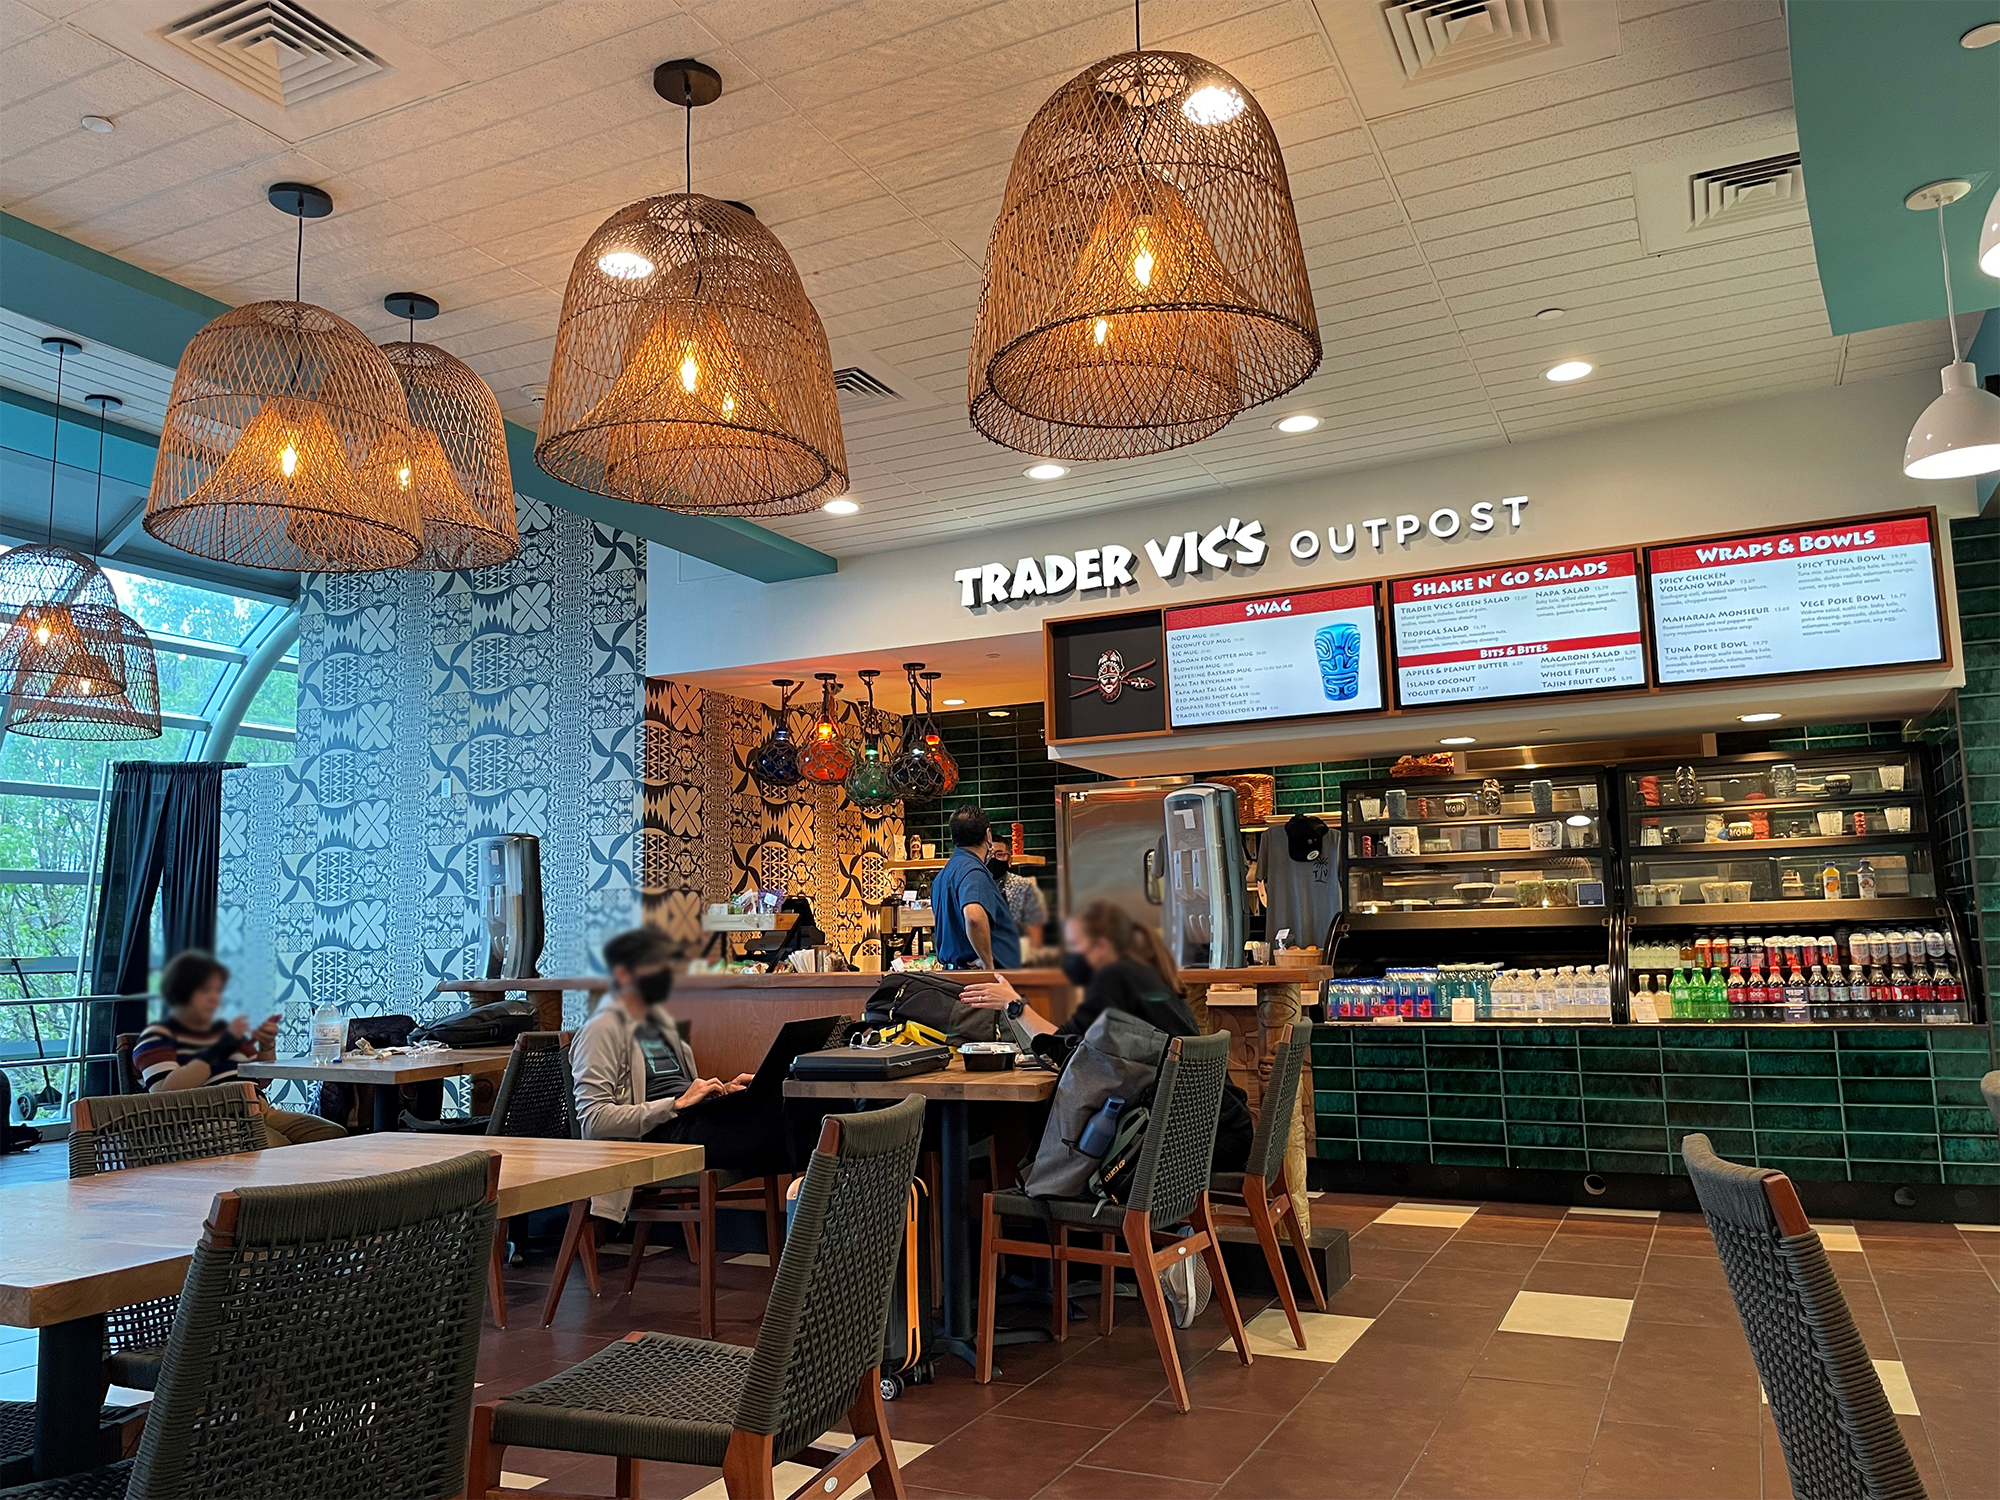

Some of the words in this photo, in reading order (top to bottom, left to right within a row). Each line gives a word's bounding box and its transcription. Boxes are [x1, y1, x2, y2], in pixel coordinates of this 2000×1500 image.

[954, 544, 1137, 608] TRADER
[1144, 517, 1268, 578] VIC'S
[1289, 495, 1529, 559] OUTPOST
[1696, 542, 1772, 564] WRAPS
[1778, 538, 1794, 554] &
[1800, 530, 1876, 552] BOWLS
[1797, 561, 1823, 569] SPICY
[1857, 554, 1885, 562] BOWL
[1412, 576, 1473, 597] SHAKE
[1499, 569, 1529, 586] GO
[1533, 559, 1608, 582] SALADS
[1659, 576, 1683, 585] SPICY
[1685, 572, 1725, 581] CHICKEN
[1562, 586, 1589, 594] SALAD
[1659, 582, 1704, 592] VOLCANO
[1706, 579, 1734, 587] WRAP
[1400, 605, 1431, 614] TRADER
[1454, 599, 1480, 607] GREEN
[1483, 596, 1509, 604] SALAD
[1800, 599, 1824, 607] VEGE
[1827, 597, 1852, 605] POKE
[1856, 594, 1885, 602] BOWL
[1246, 598, 1292, 617] SWAG
[1662, 613, 1715, 623] MAHARAJA
[1718, 607, 1769, 617] MONSIEUR
[1402, 628, 1440, 637] TROPICAL
[1443, 625, 1468, 633] SALAD
[1479, 647, 1504, 658] BITS
[1505, 646, 1515, 655] &
[1516, 642, 1548, 654] BITES
[1693, 643, 1717, 651] POKE
[1540, 653, 1589, 663] MACARONI
[1591, 650, 1620, 658] SALAD
[1405, 668, 1434, 676] APPLES
[1443, 664, 1475, 672] PEANUT
[1477, 661, 1508, 669] BUTTER
[1540, 669, 1571, 677] WHOLE
[1437, 676, 1475, 685] COCONUT
[1595, 675, 1616, 683] CUPS
[1407, 689, 1438, 697] YOGURT
[1441, 685, 1473, 693] PARFAIT
